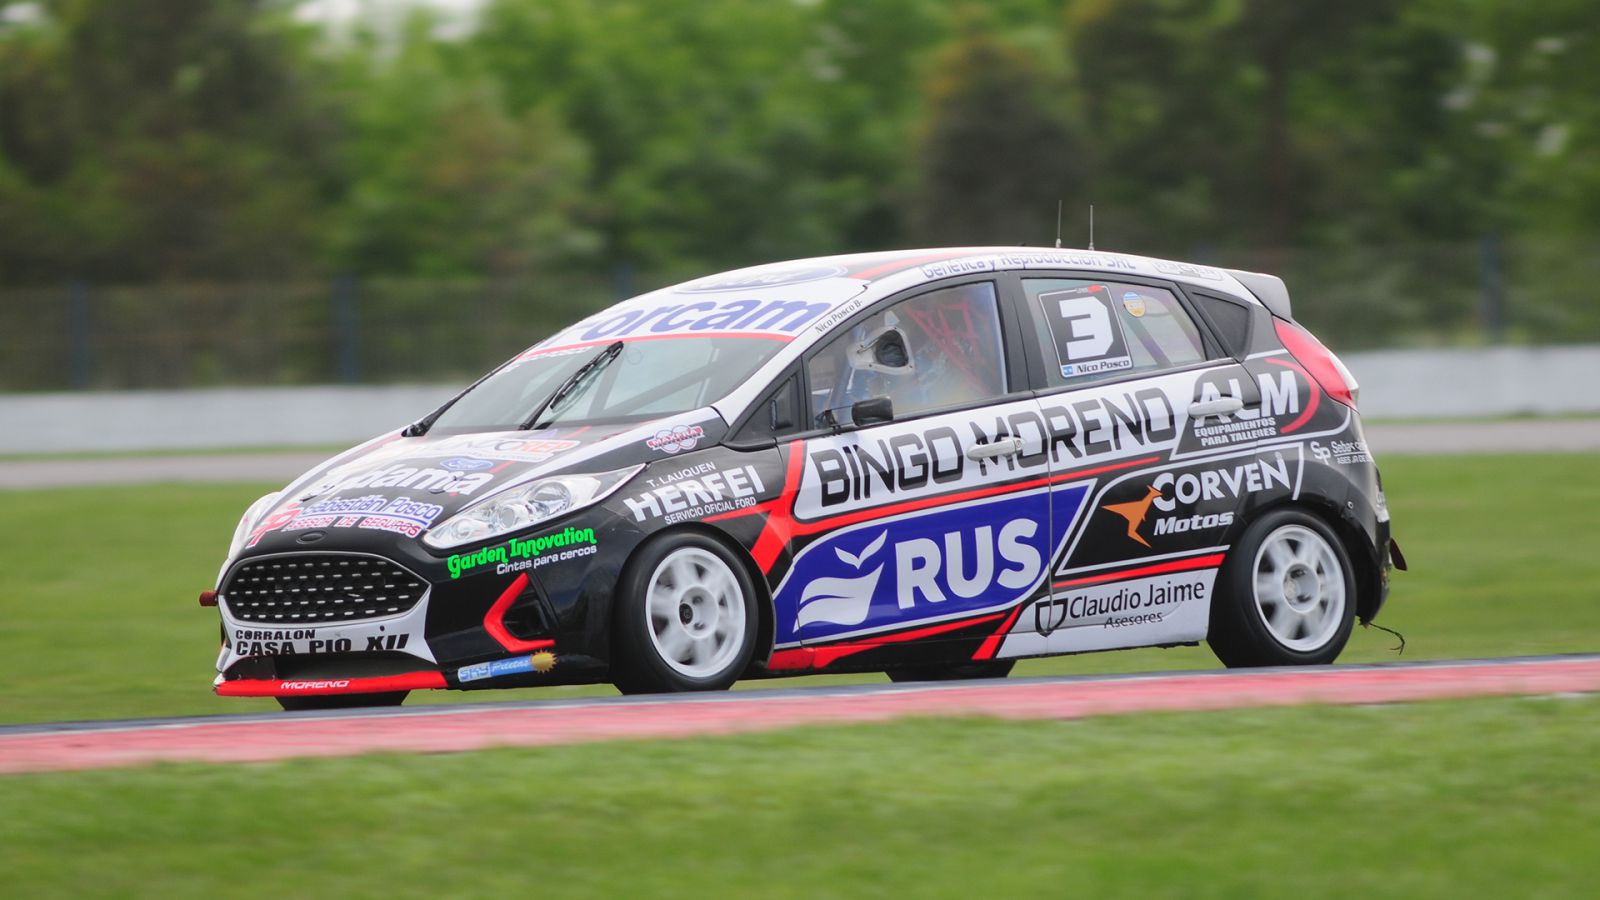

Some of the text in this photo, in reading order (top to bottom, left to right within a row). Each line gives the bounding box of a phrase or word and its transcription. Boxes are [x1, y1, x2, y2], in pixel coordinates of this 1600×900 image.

[831, 303, 854, 322] Posco
[1059, 296, 1114, 360] 3
[1076, 360, 1129, 374] Nico Posco
[1194, 370, 1299, 428] ALM
[1194, 417, 1276, 437] EQUIPAMIENTOS
[1201, 427, 1277, 447] PARA TALLERES
[810, 388, 1177, 507] BINGO MORENO
[646, 461, 717, 488] T. LAUQUEN
[1151, 456, 1291, 512] CORVEN
[623, 465, 766, 523] HERFEI
[391, 497, 441, 521] Posco
[664, 496, 757, 525] SERVICIO OFICIAL FORD
[336, 514, 357, 528] DE
[359, 515, 423, 537] SEGUROS
[1153, 511, 1235, 536] Motos
[447, 526, 598, 579] Garden Innovation
[496, 545, 598, 575] Cintas para cercos
[895, 518, 1042, 610] RUS
[1069, 581, 1205, 618] Claudio Jaime
[1103, 611, 1163, 629] Asesores
[235, 629, 316, 640] CORRALON
[235, 633, 410, 656] CASA PIO XII
[280, 680, 350, 690] MORENO
